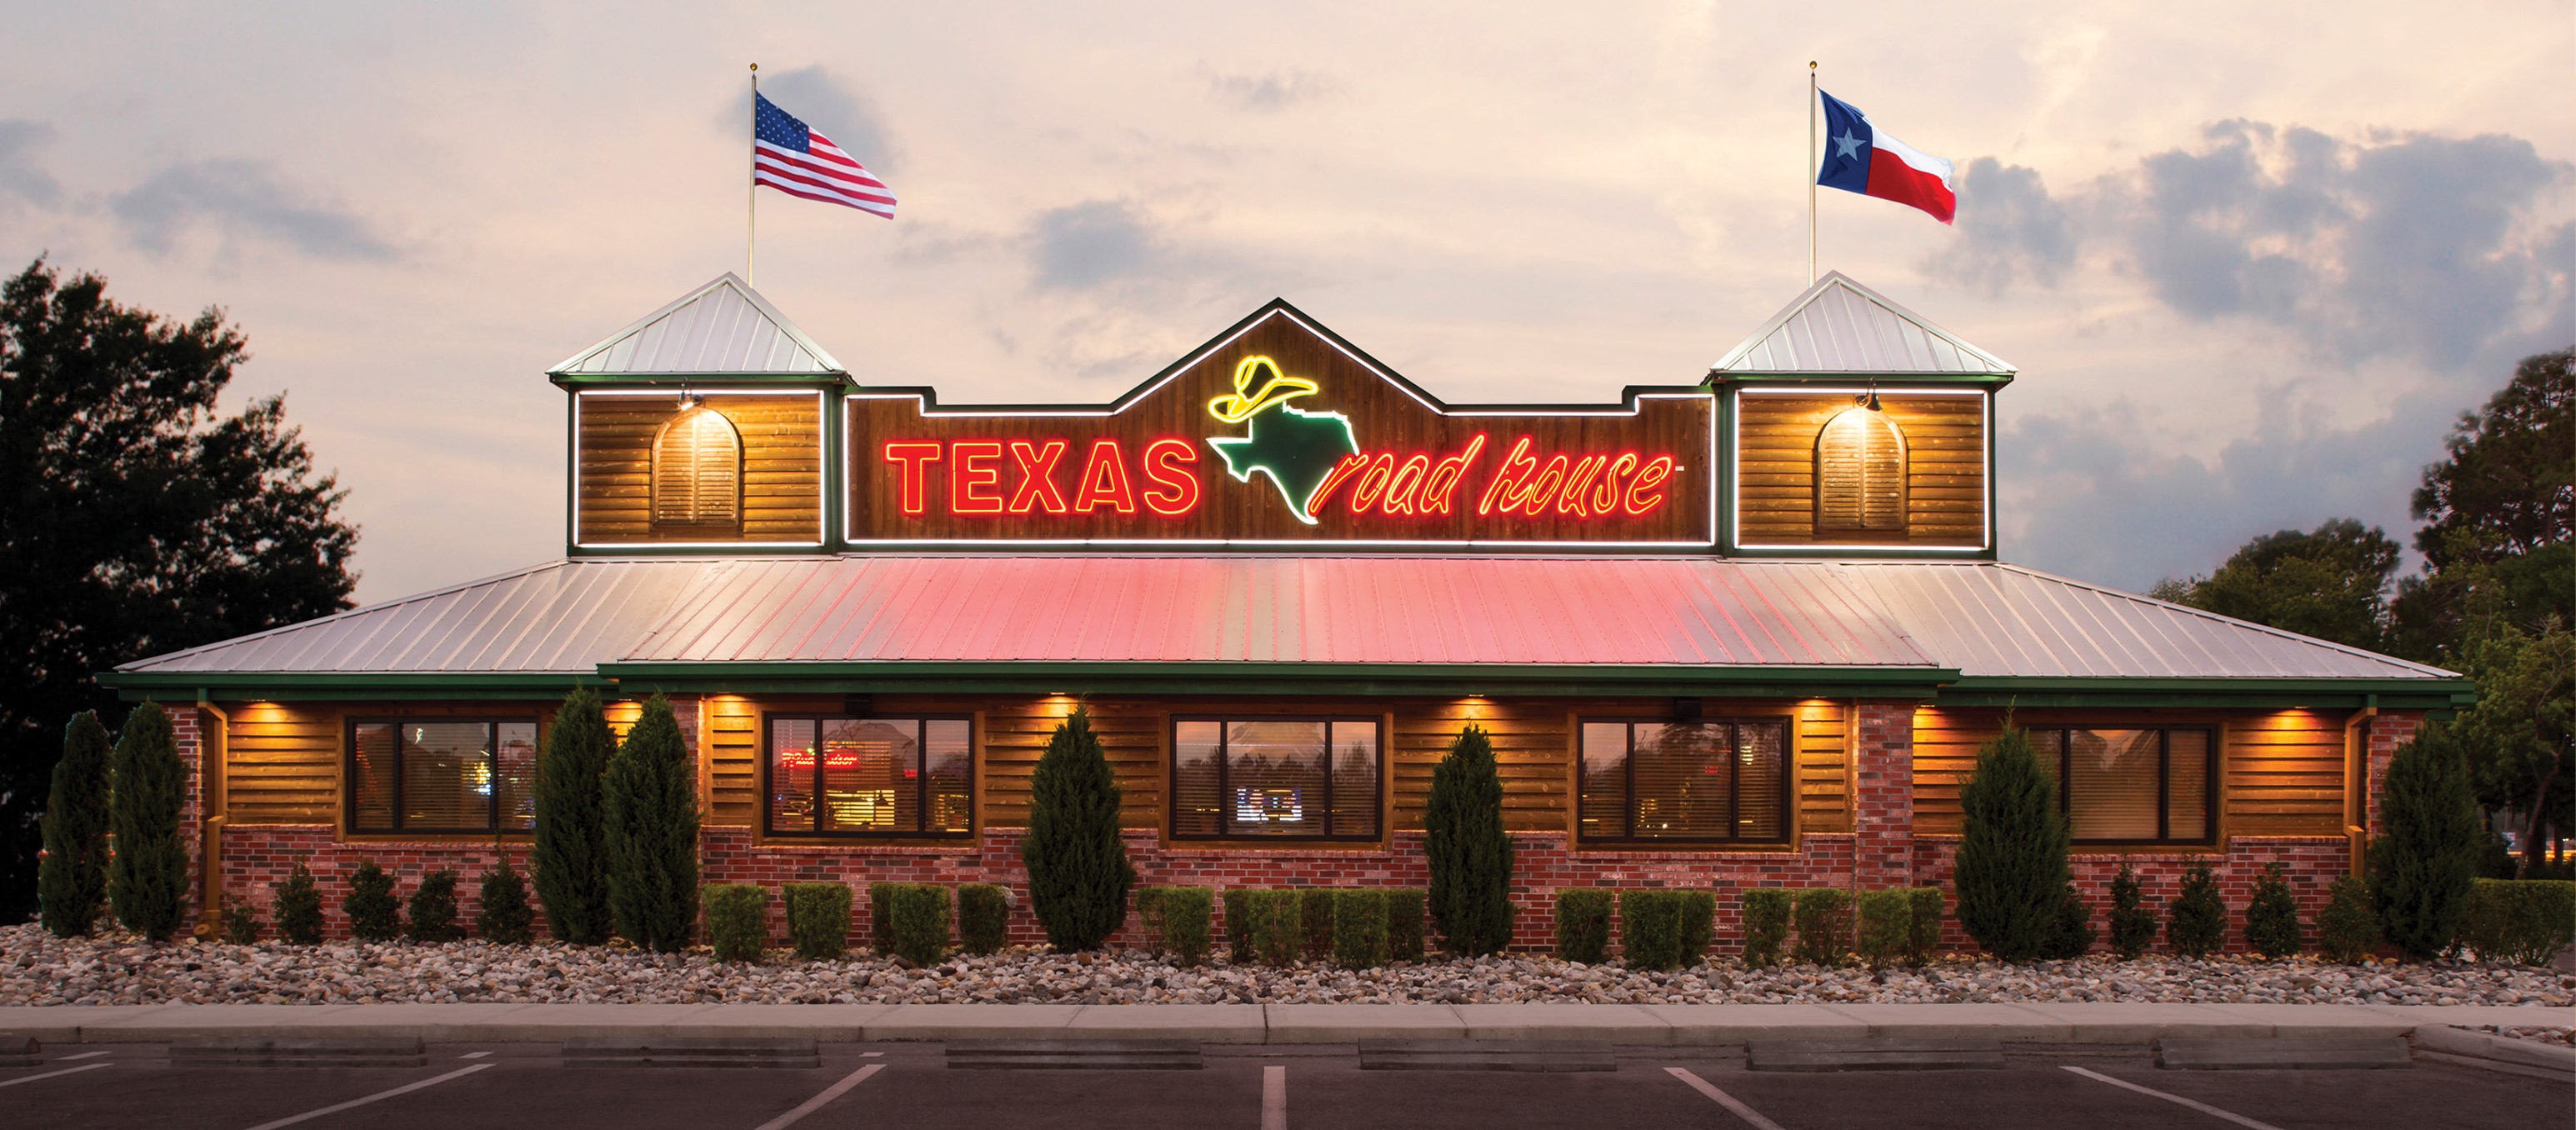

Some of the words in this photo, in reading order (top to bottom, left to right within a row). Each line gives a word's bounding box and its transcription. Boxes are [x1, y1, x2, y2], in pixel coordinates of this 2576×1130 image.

[885, 438, 1199, 515] TEXAS
[1308, 433, 1486, 516] road
[1478, 437, 1672, 517] house
